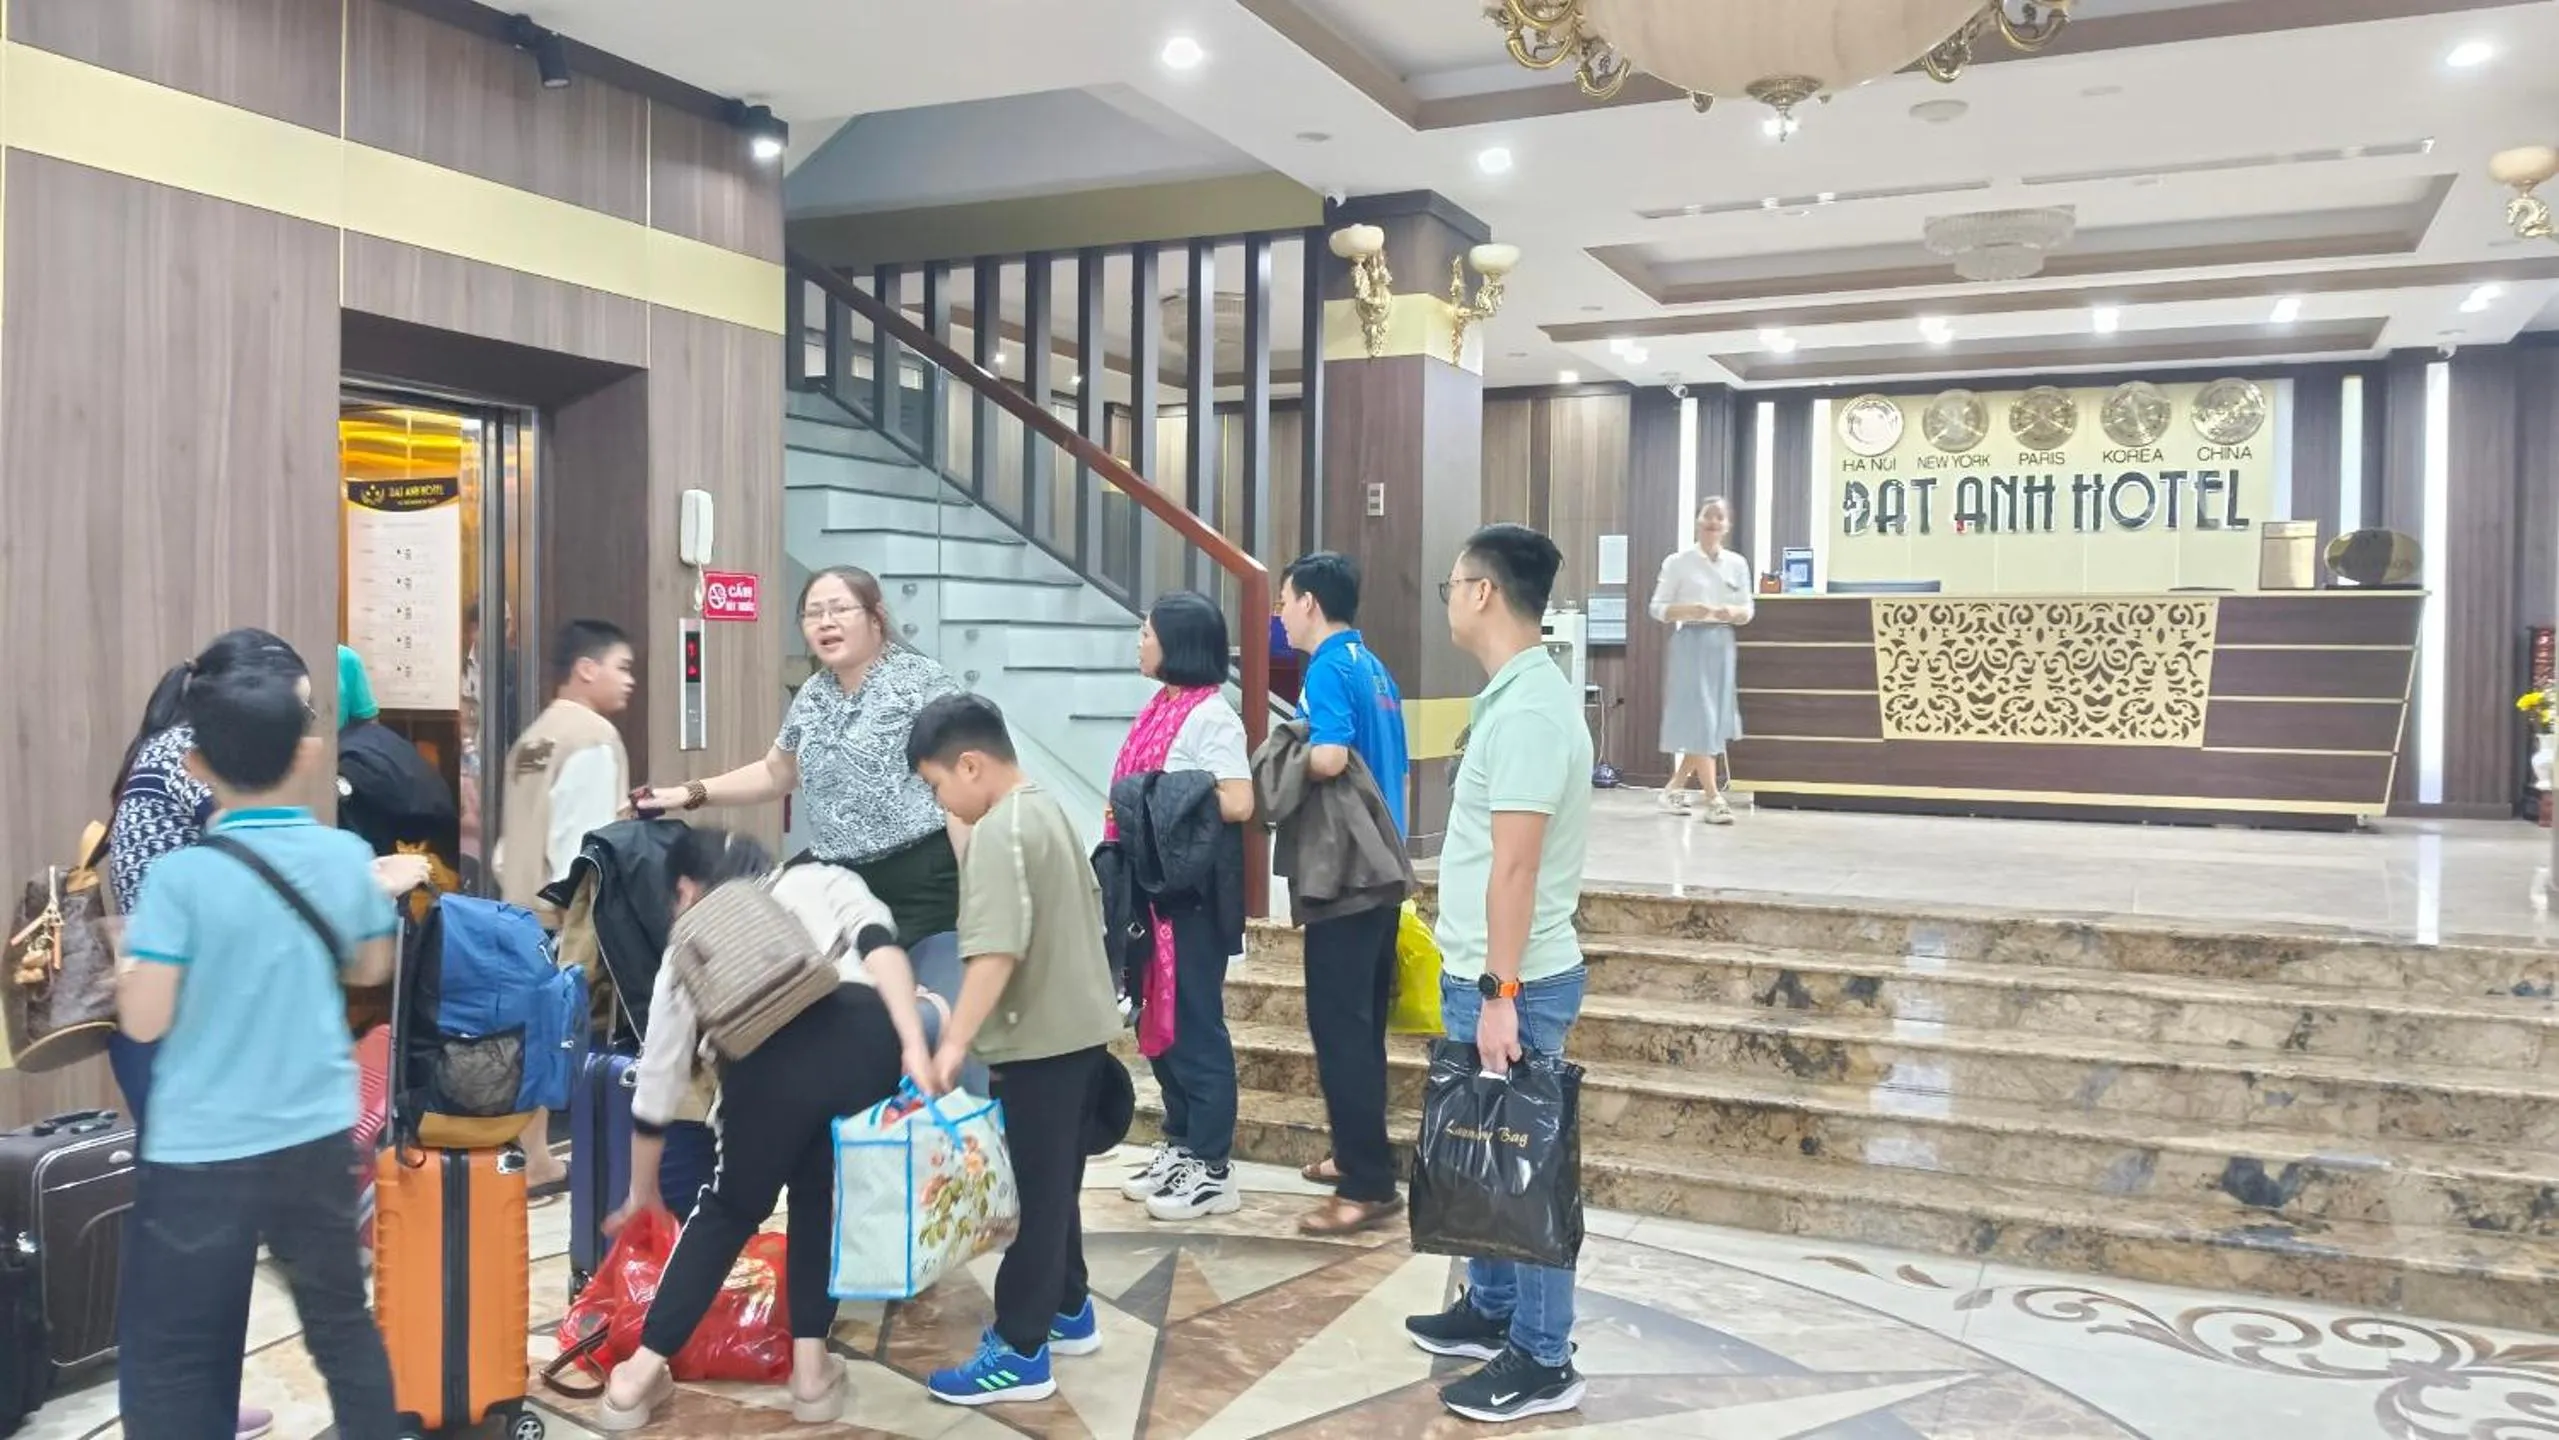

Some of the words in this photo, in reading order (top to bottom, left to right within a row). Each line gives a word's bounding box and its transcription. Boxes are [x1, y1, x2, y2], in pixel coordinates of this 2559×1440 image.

[1917, 455, 1949, 469] NEW
[1951, 453, 1991, 468] YORK
[2018, 451, 2066, 466] PARIS
[2102, 449, 2164, 464] KOREA
[2196, 446, 2253, 462] CHINA
[1954, 474, 2057, 534] ANH
[2072, 468, 2250, 532] HOTEL
[1499, 1126, 1529, 1149] Bag
